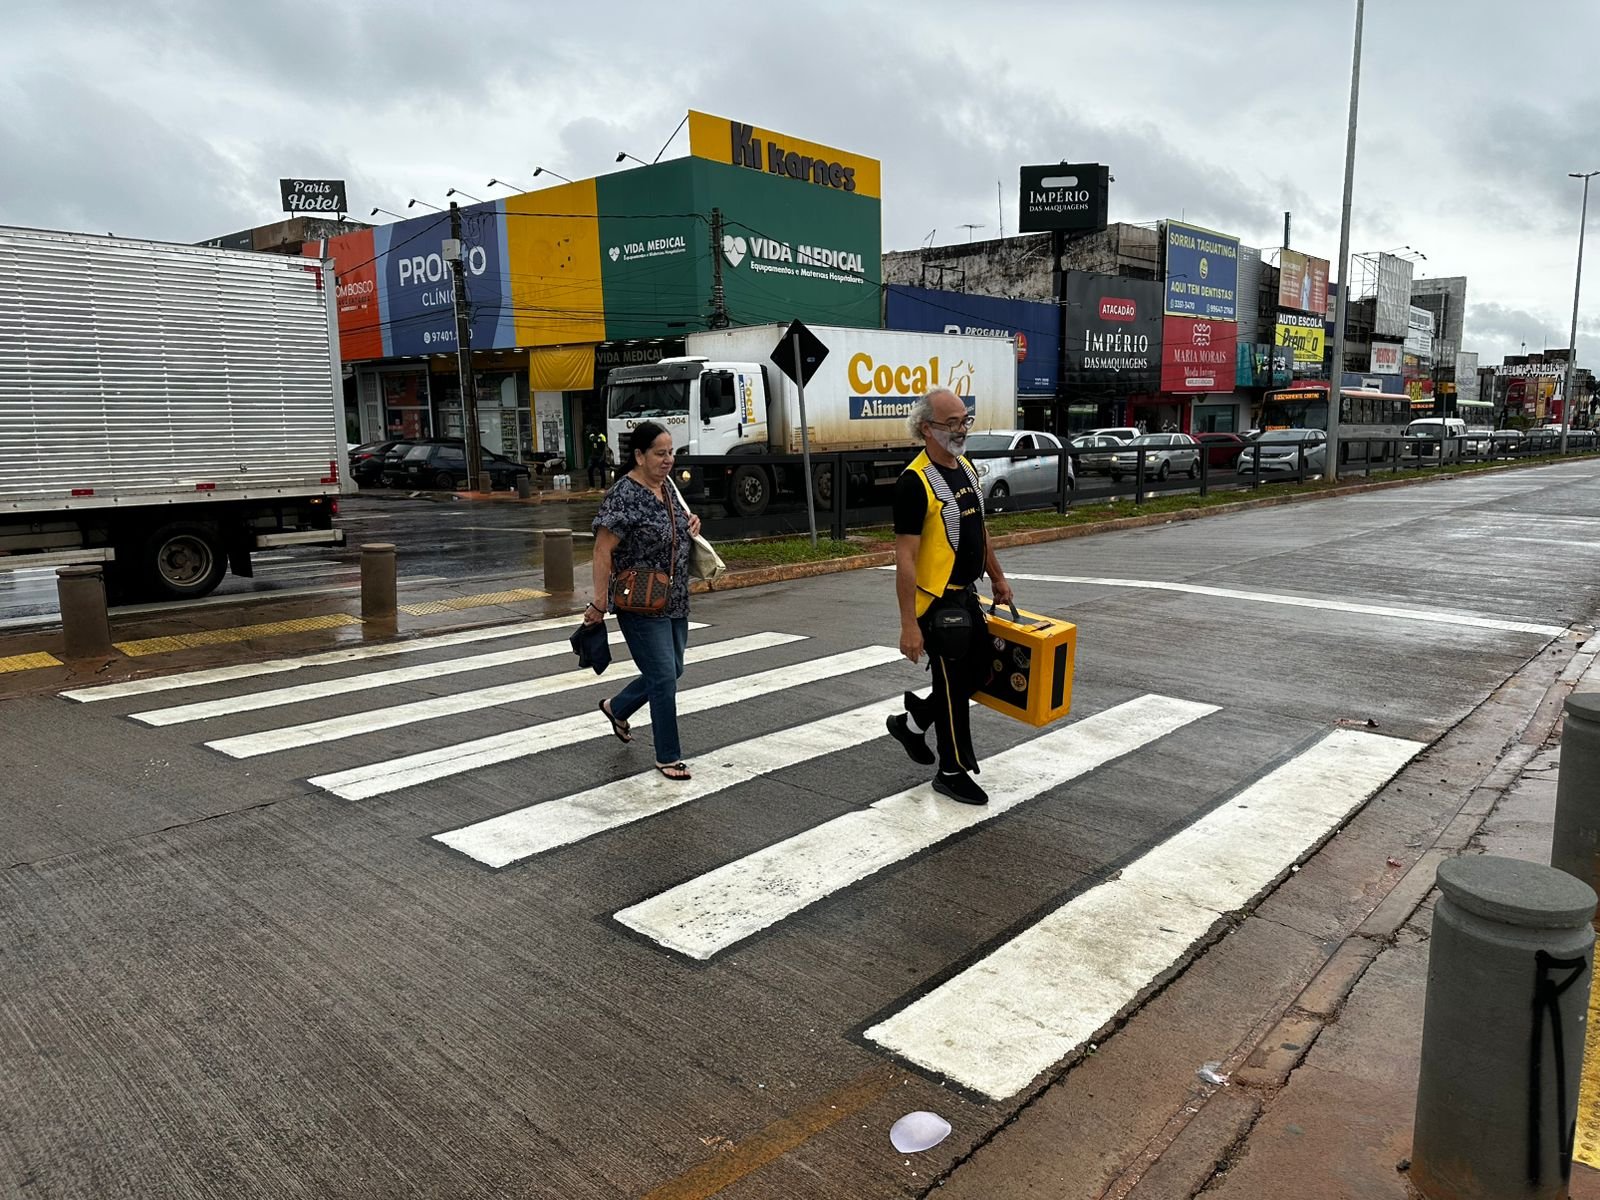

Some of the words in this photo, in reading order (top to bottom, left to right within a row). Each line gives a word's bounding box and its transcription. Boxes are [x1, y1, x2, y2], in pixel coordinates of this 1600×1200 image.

[767, 141, 856, 191] karnes
[293, 180, 331, 193] Paris
[288, 193, 341, 210] Hotel
[1029, 187, 1090, 204] IMPÉRIO
[1029, 205, 1043, 213] DAS
[1043, 203, 1089, 213] MAQUIAGENS
[623, 242, 645, 255] VIDA
[647, 236, 686, 252] MEDICAL
[1169, 232, 1196, 249] SORRIA
[1196, 238, 1237, 259] TAGUATINGA
[750, 237, 793, 262] VIDA
[797, 245, 865, 273] MEDICAL
[750, 260, 795, 276] Equipamentos
[800, 268, 829, 280] Materiais
[335, 285, 348, 298] OM
[348, 279, 374, 296] BOSCO
[1170, 281, 1187, 294] AQUI
[1187, 284, 1200, 295] TEM
[1102, 304, 1135, 316] ATACADÃO
[1279, 313, 1297, 325] AUTO
[1298, 316, 1323, 328] ESCOLA
[964, 326, 1009, 338] DROGARIA
[1085, 327, 1149, 353] IMPÉRIO
[596, 350, 620, 363] VIDA
[623, 348, 665, 362] MEDICAL
[1084, 356, 1100, 369] DAS
[1100, 357, 1148, 372] MAQUIAGENS
[1174, 348, 1198, 362] MARIA
[1199, 350, 1227, 364] MORAIS
[848, 352, 939, 395] Cocal
[744, 376, 756, 424] Cocal
[666, 417, 687, 426] 3004
